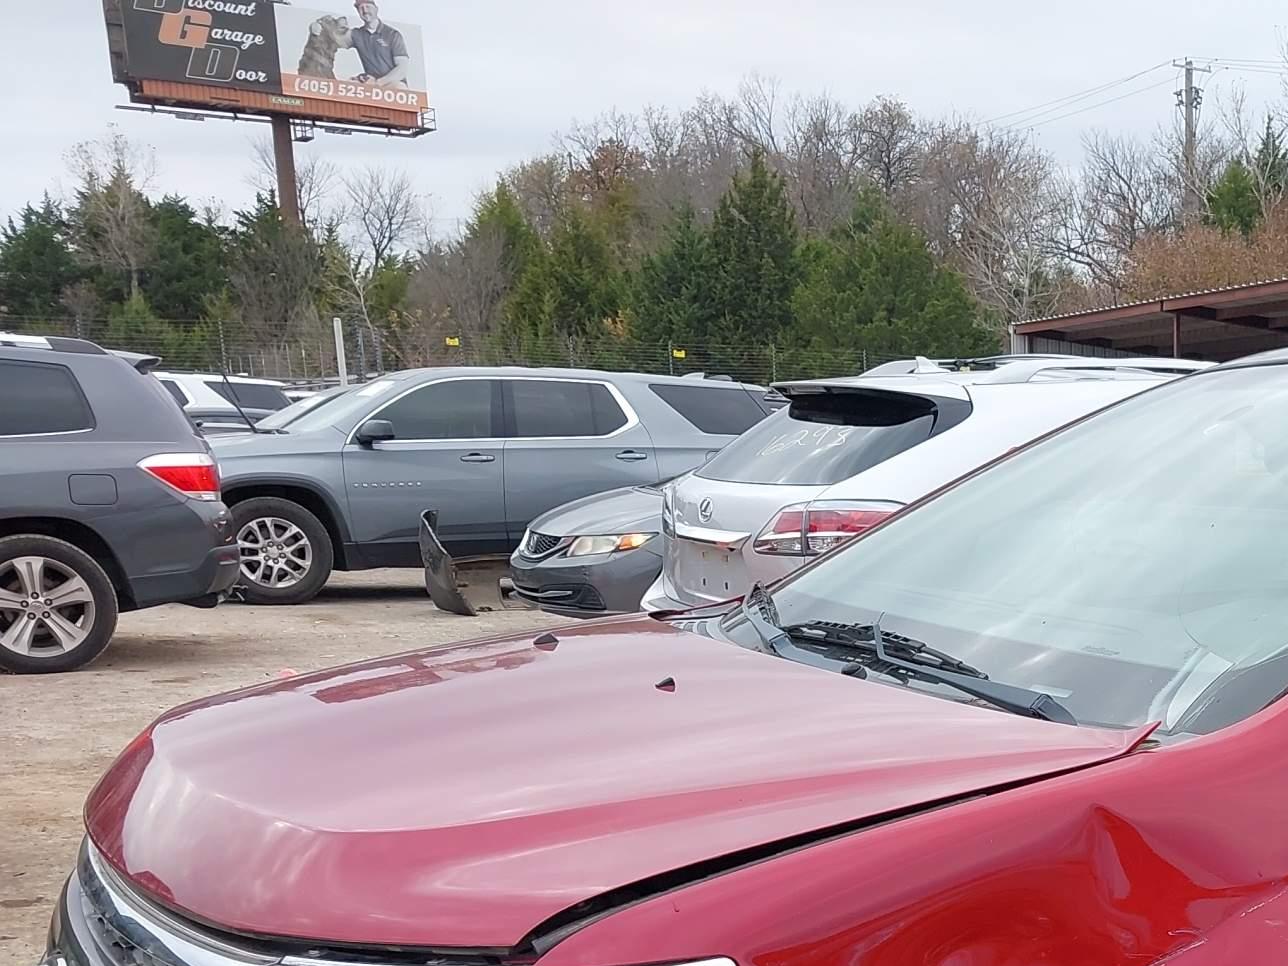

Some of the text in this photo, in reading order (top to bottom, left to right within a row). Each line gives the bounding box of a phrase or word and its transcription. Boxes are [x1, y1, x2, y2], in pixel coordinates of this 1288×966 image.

[158, 7, 266, 50] Garage
[185, 42, 268, 83] Door
[294, 77, 419, 106] (405) 525-DOOR
